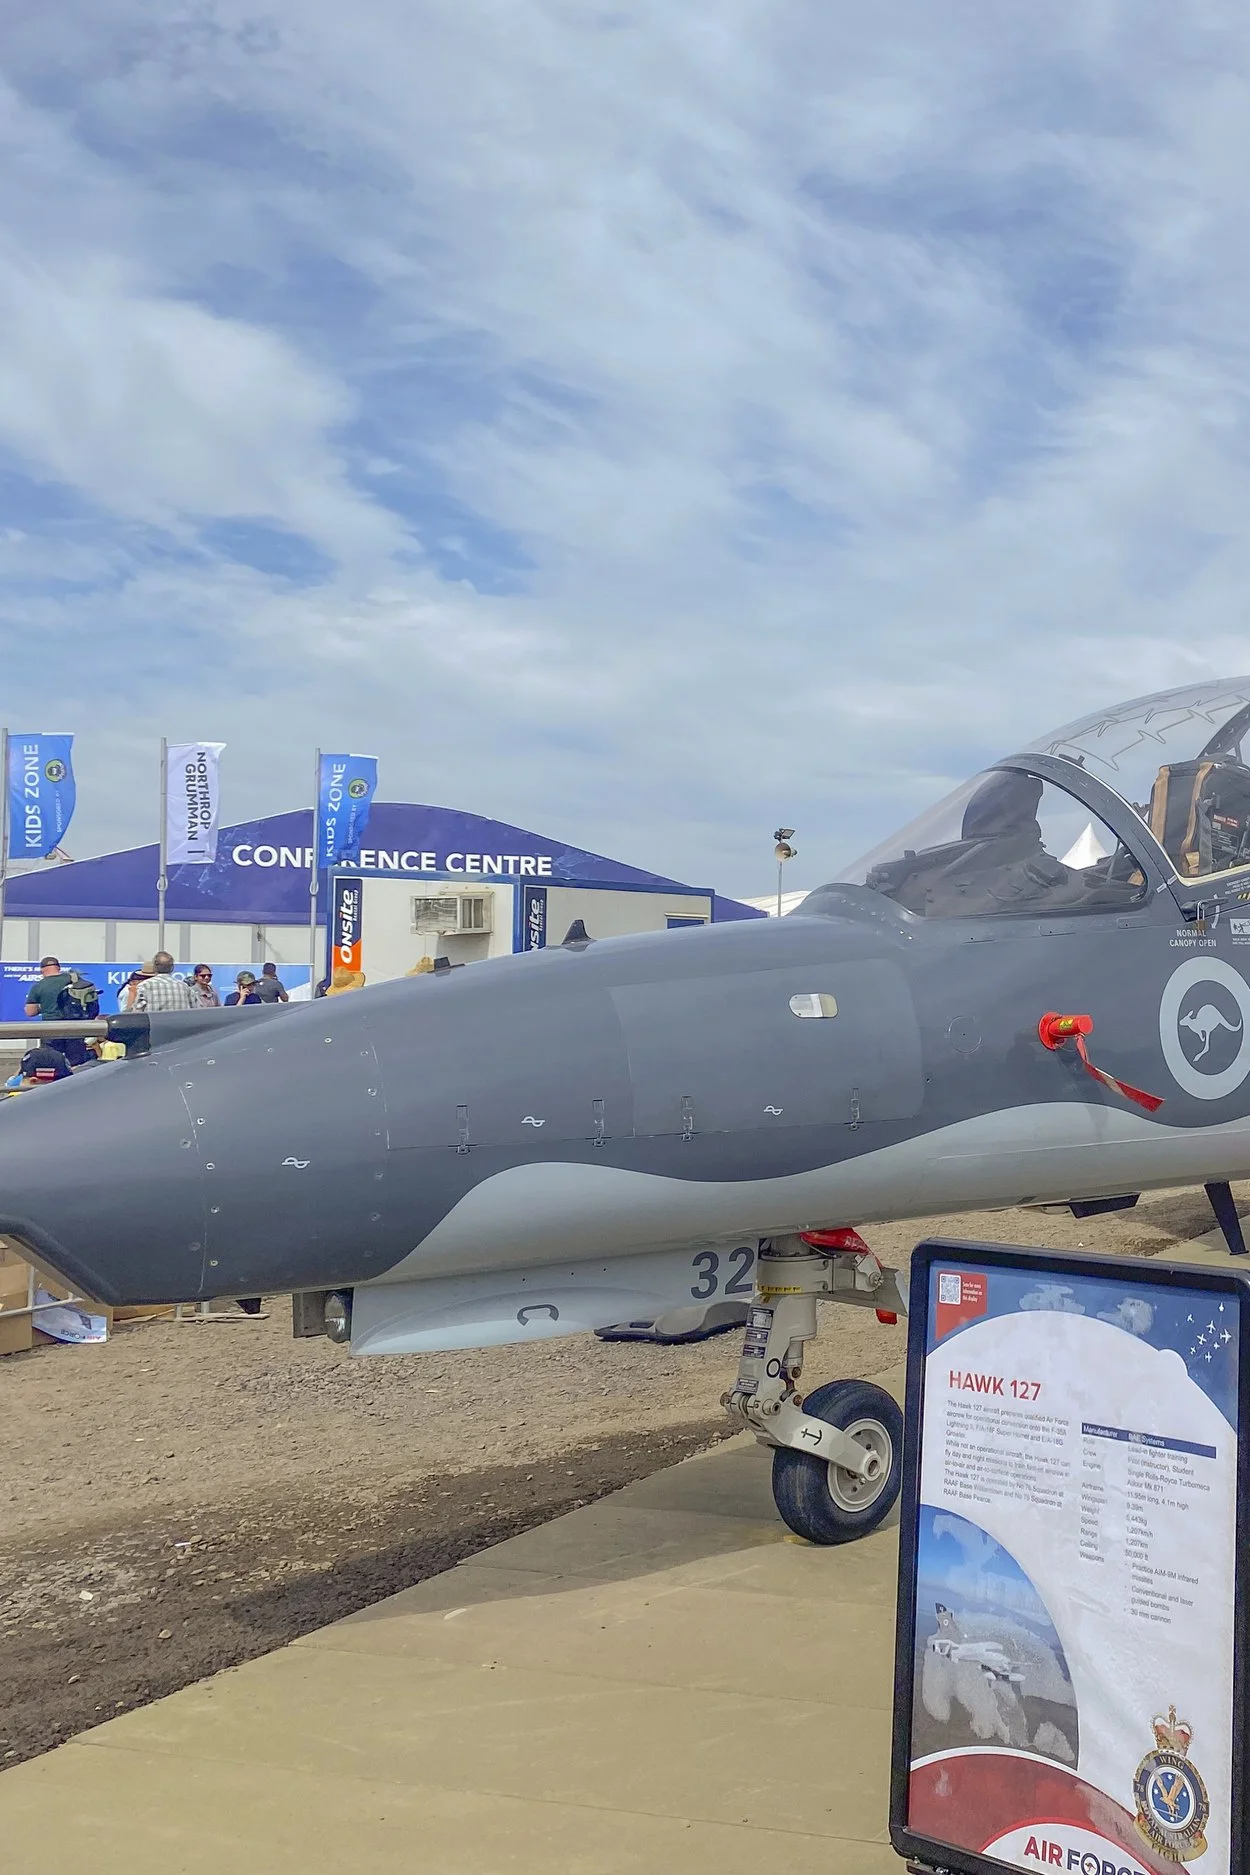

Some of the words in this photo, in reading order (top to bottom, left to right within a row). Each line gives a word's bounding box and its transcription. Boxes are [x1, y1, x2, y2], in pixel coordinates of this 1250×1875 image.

[24, 744, 40, 798] ZONE
[196, 752, 212, 830] NORTHROP
[328, 764, 346, 812] ZONE
[186, 764, 198, 840] GRUMMAN
[25, 804, 42, 848] KIDS
[326, 817, 336, 857] KIDS
[446, 852, 552, 876] CENTRE
[690, 1246, 755, 1300] 32
[949, 1370, 1004, 1396] HAWK
[1010, 1379, 1041, 1401] 127
[973, 1414, 1000, 1425] operational
[983, 1406, 1000, 1415] aircraft
[1025, 1412, 1045, 1422] qualified
[1054, 1417, 1069, 1426] Force
[946, 1420, 969, 1431] Lightning
[996, 1428, 1012, 1437] Super
[1083, 1425, 1118, 1438] Manufacturer
[1129, 1433, 1141, 1443] BAE
[1142, 1435, 1165, 1446] Systems
[946, 1440, 959, 1448] While
[977, 1445, 1004, 1456] operational
[1034, 1454, 1048, 1463] Hawk
[952, 1451, 961, 1459] day
[972, 1455, 985, 1463] night
[1149, 1449, 1166, 1459] fighter
[1167, 1452, 1188, 1464] training
[1082, 1460, 1101, 1470] Engine
[1128, 1469, 1144, 1479] Single
[1145, 1471, 1178, 1485] Rolls-Royce
[1179, 1479, 1211, 1492] Turbomeca
[1172, 1465, 1194, 1476] Student
[943, 1488, 958, 1497] RAAF
[959, 1491, 972, 1499] Base
[944, 1478, 958, 1487] RAAF
[960, 1481, 972, 1489] Base
[1031, 1495, 1056, 1506] Squadron
[955, 1470, 969, 1479] Hawk
[1033, 1485, 1057, 1496] Squadron
[1127, 1480, 1144, 1489] Adour
[1144, 1483, 1153, 1491] Mk
[1154, 1485, 1164, 1493] 871
[1082, 1482, 1104, 1492] Airframe
[1127, 1491, 1146, 1500] 11.95m
[1161, 1496, 1176, 1507] 4.1m
[1177, 1500, 1189, 1510] high
[1080, 1516, 1098, 1526] Speed
[1080, 1528, 1098, 1538] Range
[1080, 1540, 1098, 1551] Ceiling
[1125, 1549, 1144, 1559] 50,000
[1080, 1551, 1104, 1563] Weapons
[1132, 1562, 1154, 1574] Practice
[1177, 1572, 1199, 1585] infrared
[1132, 1575, 1153, 1585] missiles
[1131, 1598, 1150, 1608] guided
[1150, 1601, 1170, 1611] bombs
[1132, 1585, 1168, 1600] Conventional
[1180, 1596, 1194, 1607] laser
[1139, 1611, 1150, 1619] mm
[1150, 1613, 1171, 1624] cannon
[1159, 1755, 1184, 1770] WING
[1150, 1829, 1163, 1845] AIR
[1158, 1818, 1200, 1840] AUSTRALIAN
[1024, 1836, 1062, 1868] AIR
